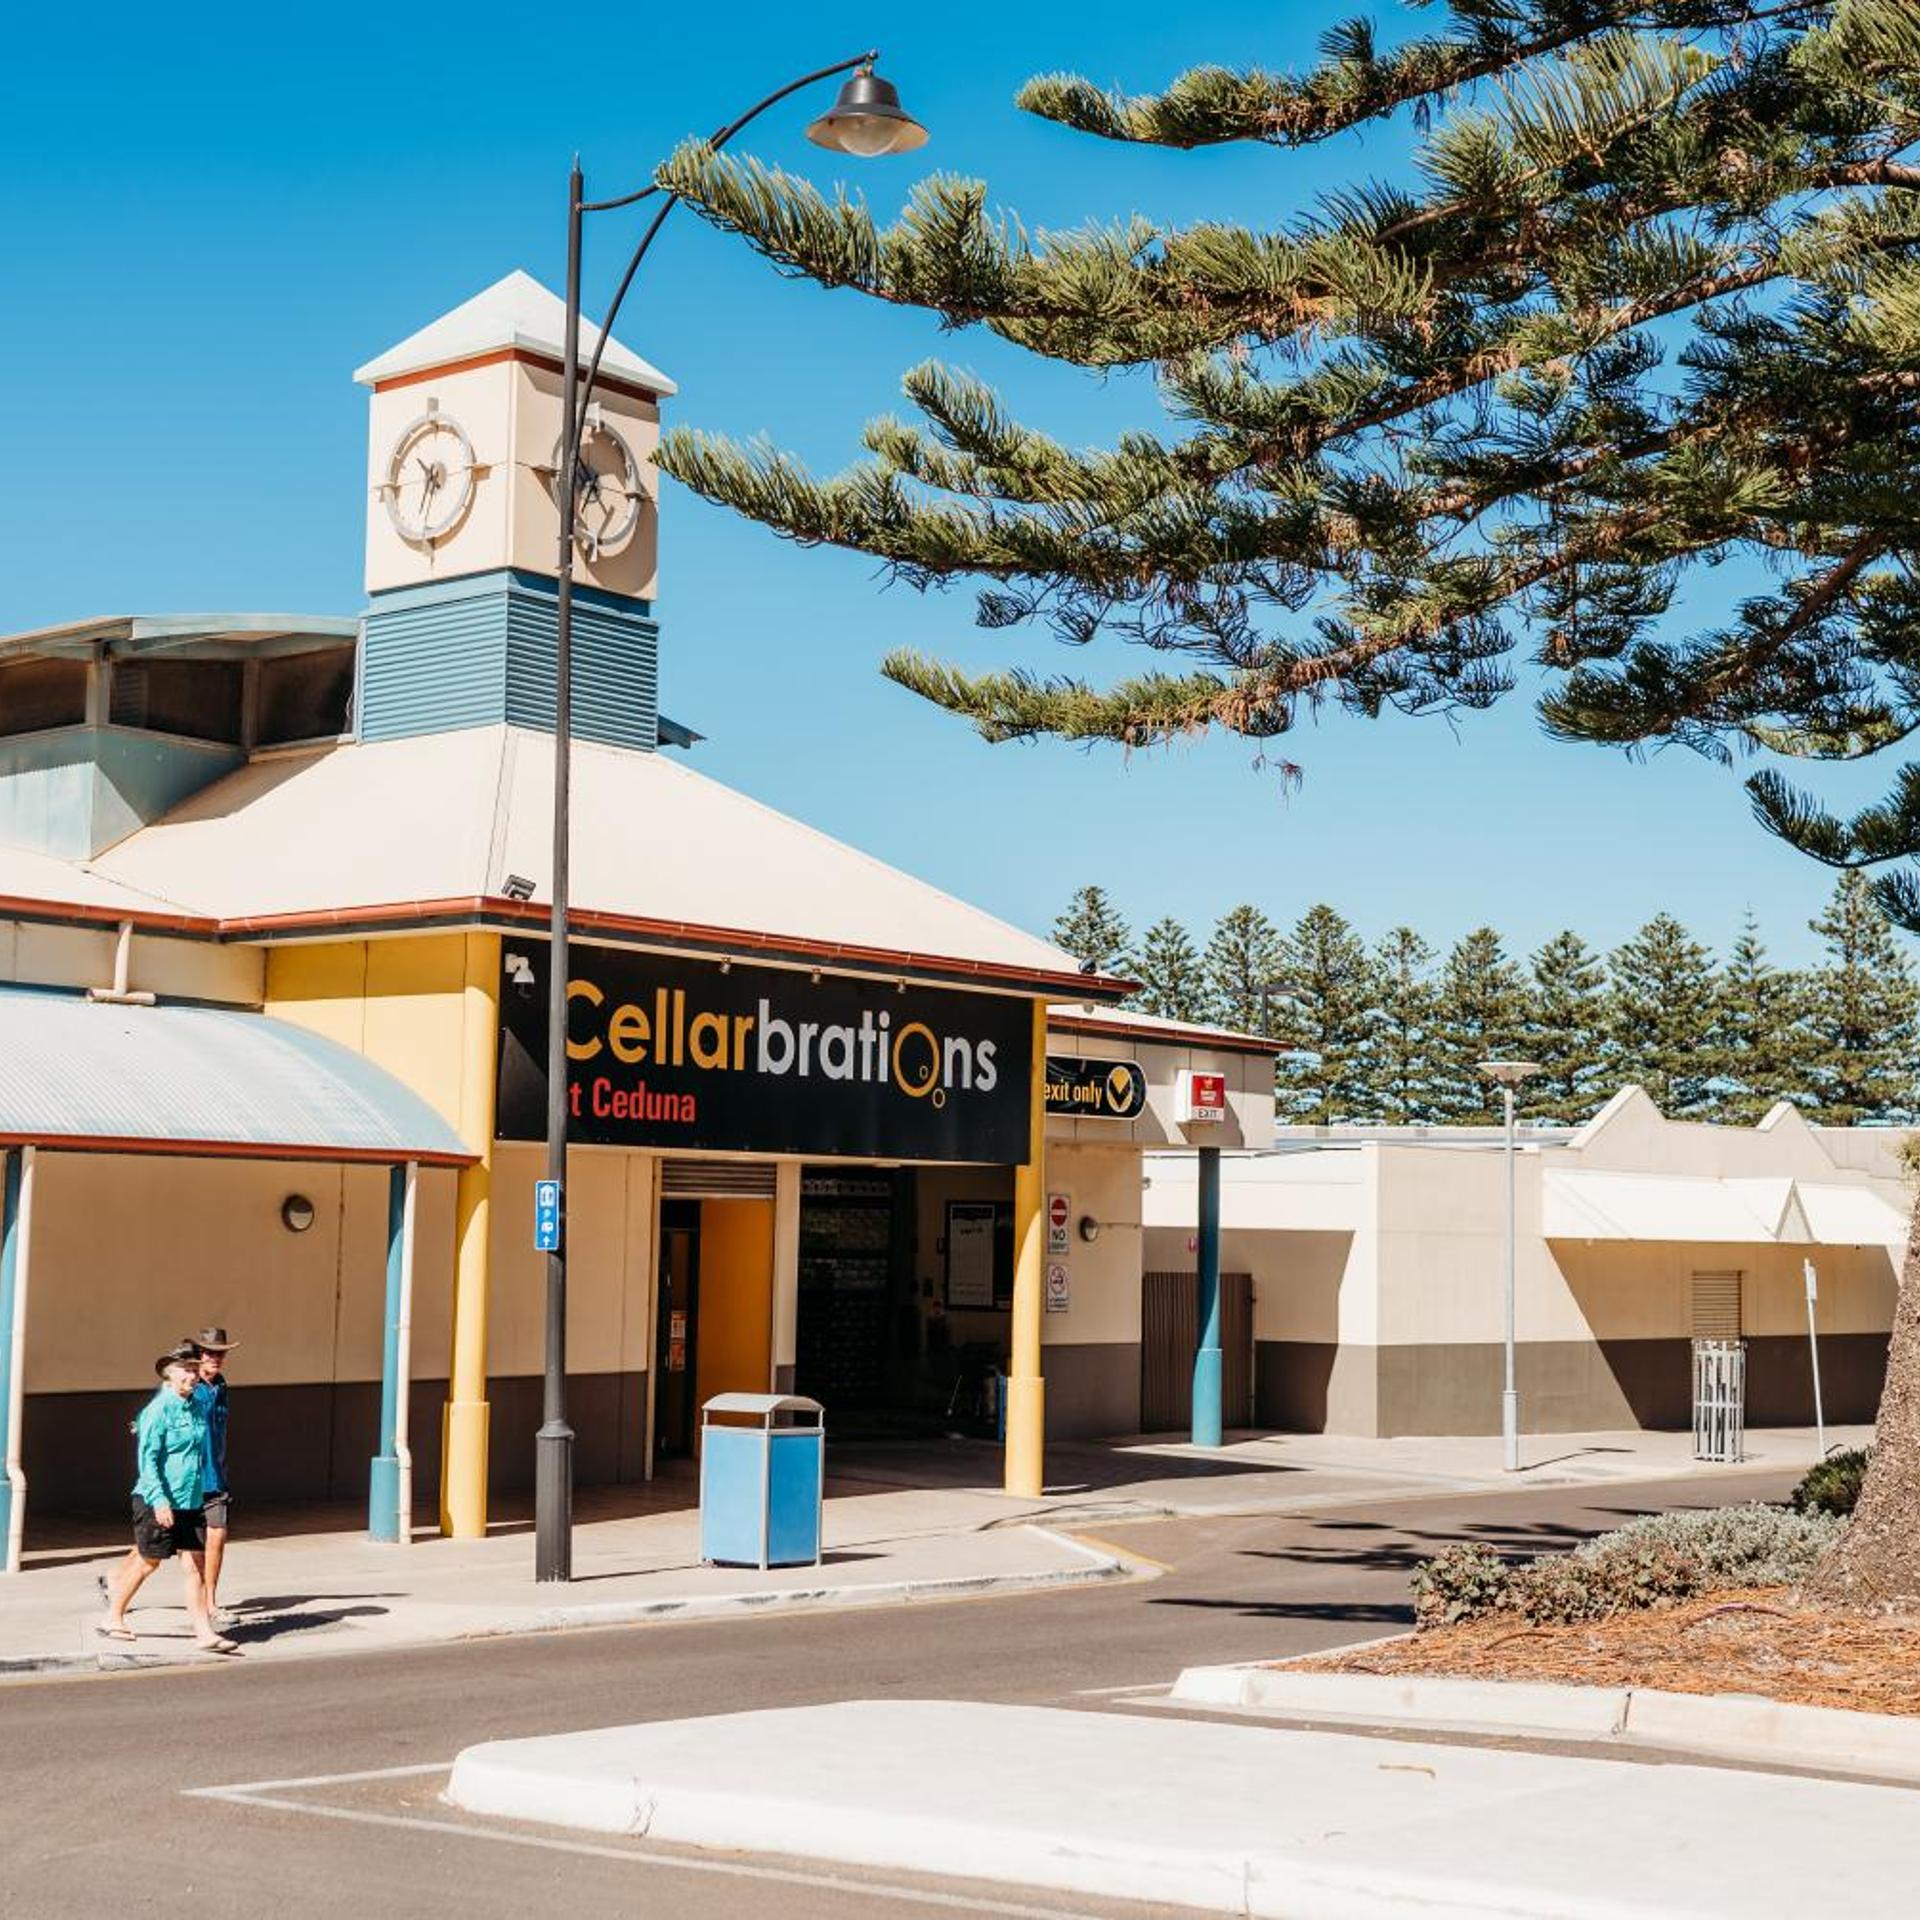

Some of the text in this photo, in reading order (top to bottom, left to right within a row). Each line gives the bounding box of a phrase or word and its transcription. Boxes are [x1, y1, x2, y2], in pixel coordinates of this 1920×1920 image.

[592, 1076, 696, 1122] Ceduna
[1043, 1077, 1102, 1109] exit only
[1198, 1109, 1217, 1118] EXIT
[1052, 1229, 1066, 1241] NO
